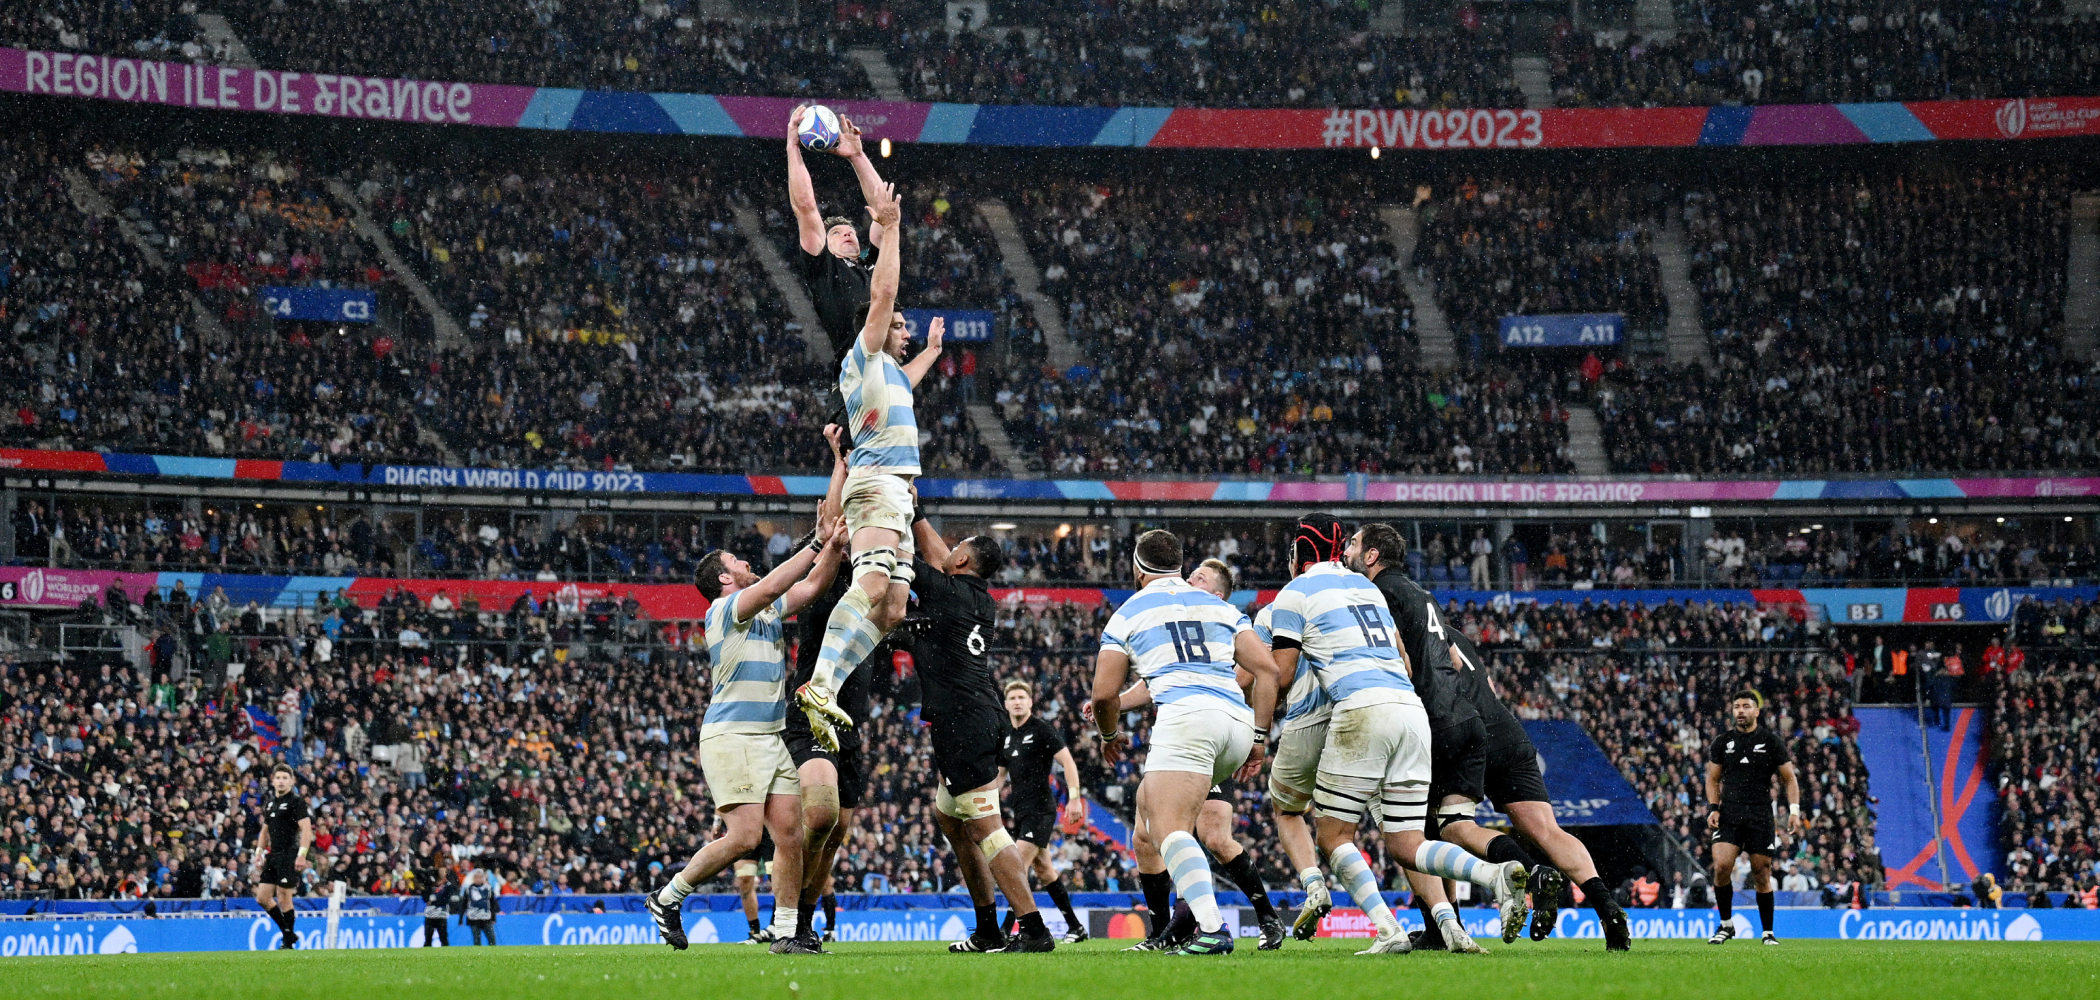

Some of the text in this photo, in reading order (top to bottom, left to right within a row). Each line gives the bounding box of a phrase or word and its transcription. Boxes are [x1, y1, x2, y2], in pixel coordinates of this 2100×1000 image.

[26, 50, 168, 102] REGION
[184, 64, 240, 109] ILE
[254, 71, 301, 112] DE
[1322, 109, 1543, 147] #RWC2023
[264, 297, 292, 316] C4
[342, 300, 369, 319] C3
[953, 320, 987, 338] B11
[1507, 325, 1544, 343] A12
[1580, 325, 1615, 342] A11
[464, 470, 539, 489] WORLD
[545, 471, 587, 491] CUP
[592, 473, 645, 491] 2023
[1396, 483, 1474, 500] REGION
[1483, 483, 1513, 500] ILE
[1520, 483, 1546, 500] DE
[1, 582, 14, 599] 6
[47, 583, 100, 594] WORLD CUP
[1426, 603, 1445, 640] 4
[1851, 604, 1879, 620] B5
[1934, 604, 1963, 619] A6
[1347, 604, 1392, 648] 19
[966, 624, 986, 656] 6
[1165, 620, 1212, 663] 18
[542, 913, 657, 945] Capgemi
[811, 910, 936, 942] Cpgemini
[1555, 908, 1715, 938] Caemini
[1839, 909, 2000, 940] Capgemini
